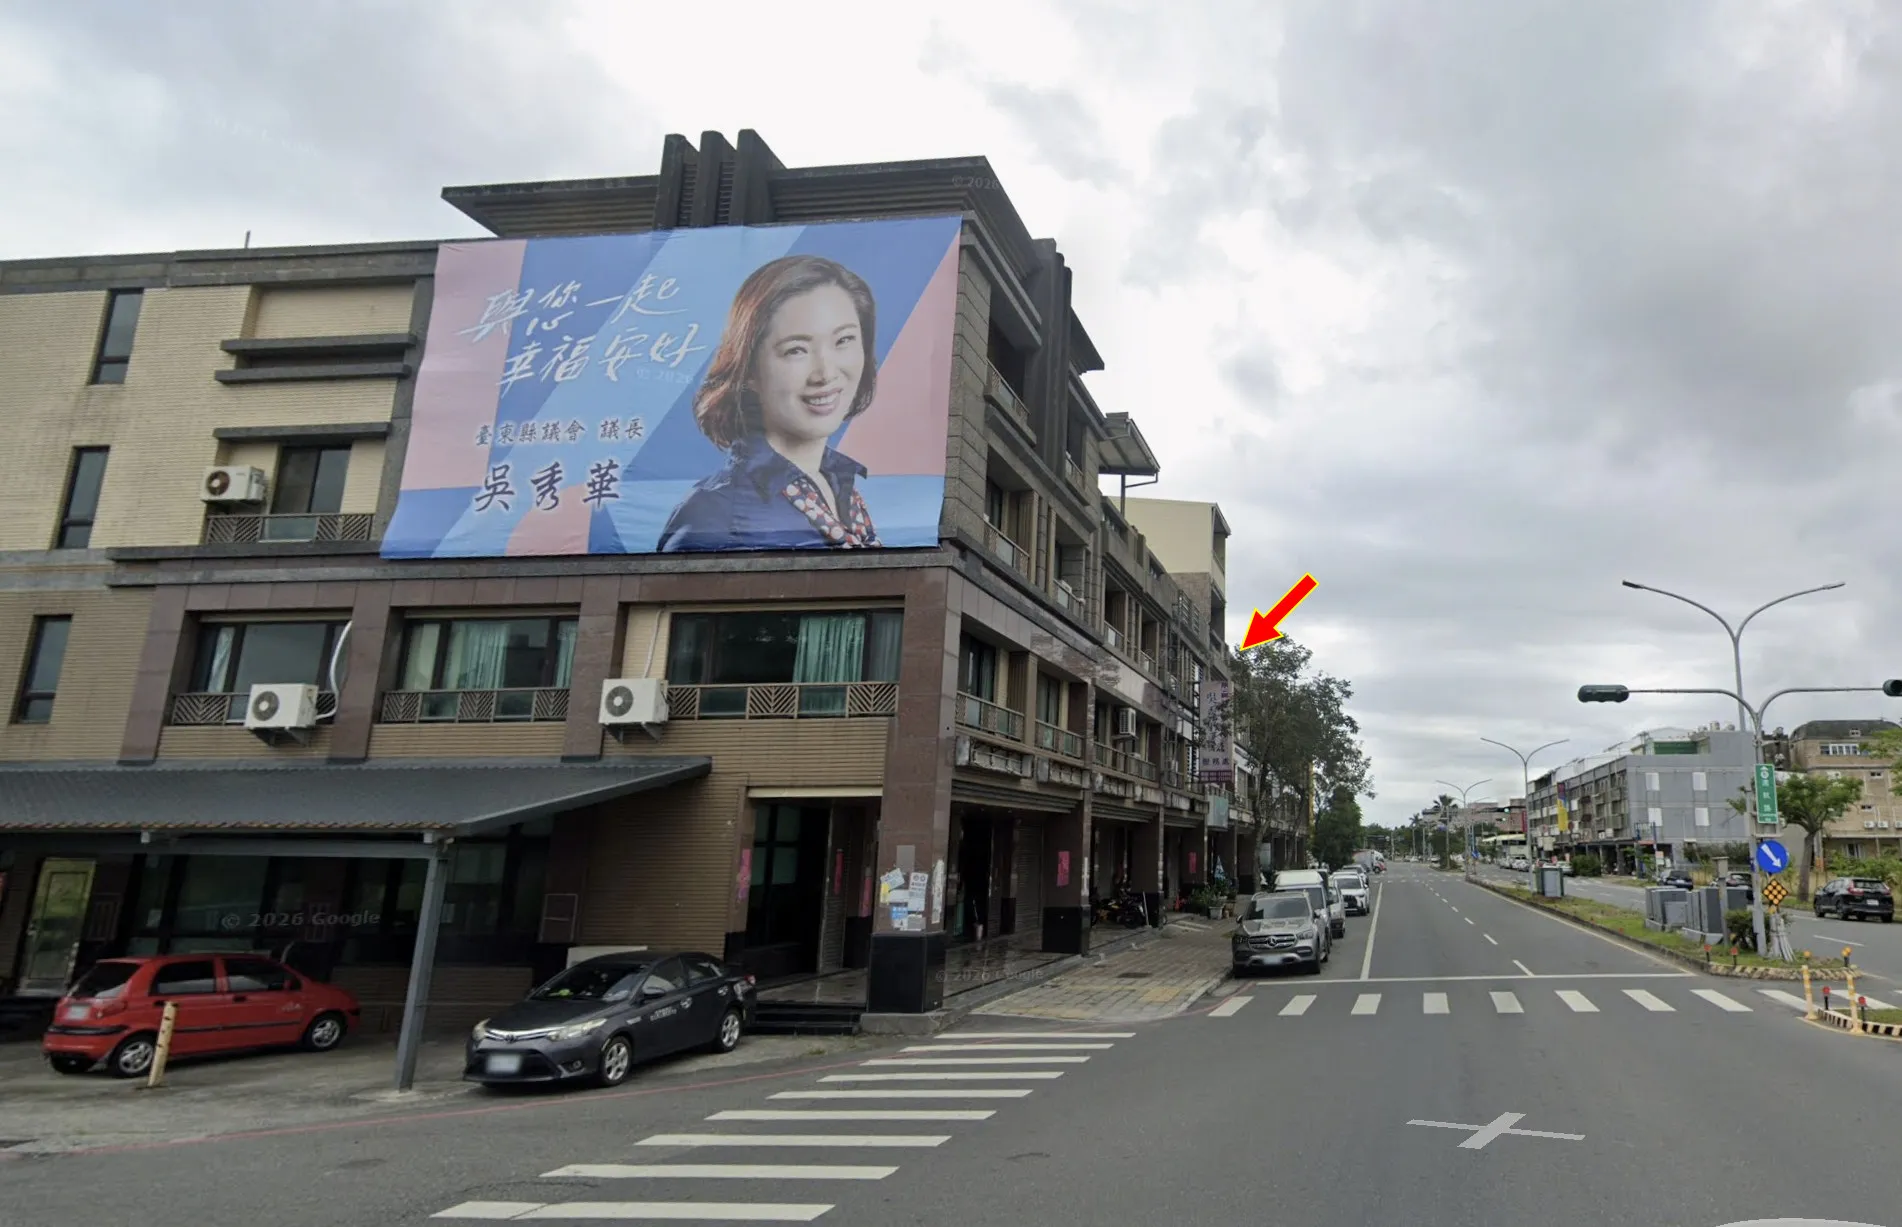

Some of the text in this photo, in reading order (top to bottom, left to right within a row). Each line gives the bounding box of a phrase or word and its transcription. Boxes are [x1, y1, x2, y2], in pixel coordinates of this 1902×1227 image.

[454, 273, 689, 343] 與您一起
[496, 323, 708, 398] 幸福安好
[475, 418, 644, 446] 臺東縣議會 議長
[474, 459, 621, 512] 吳秀華
